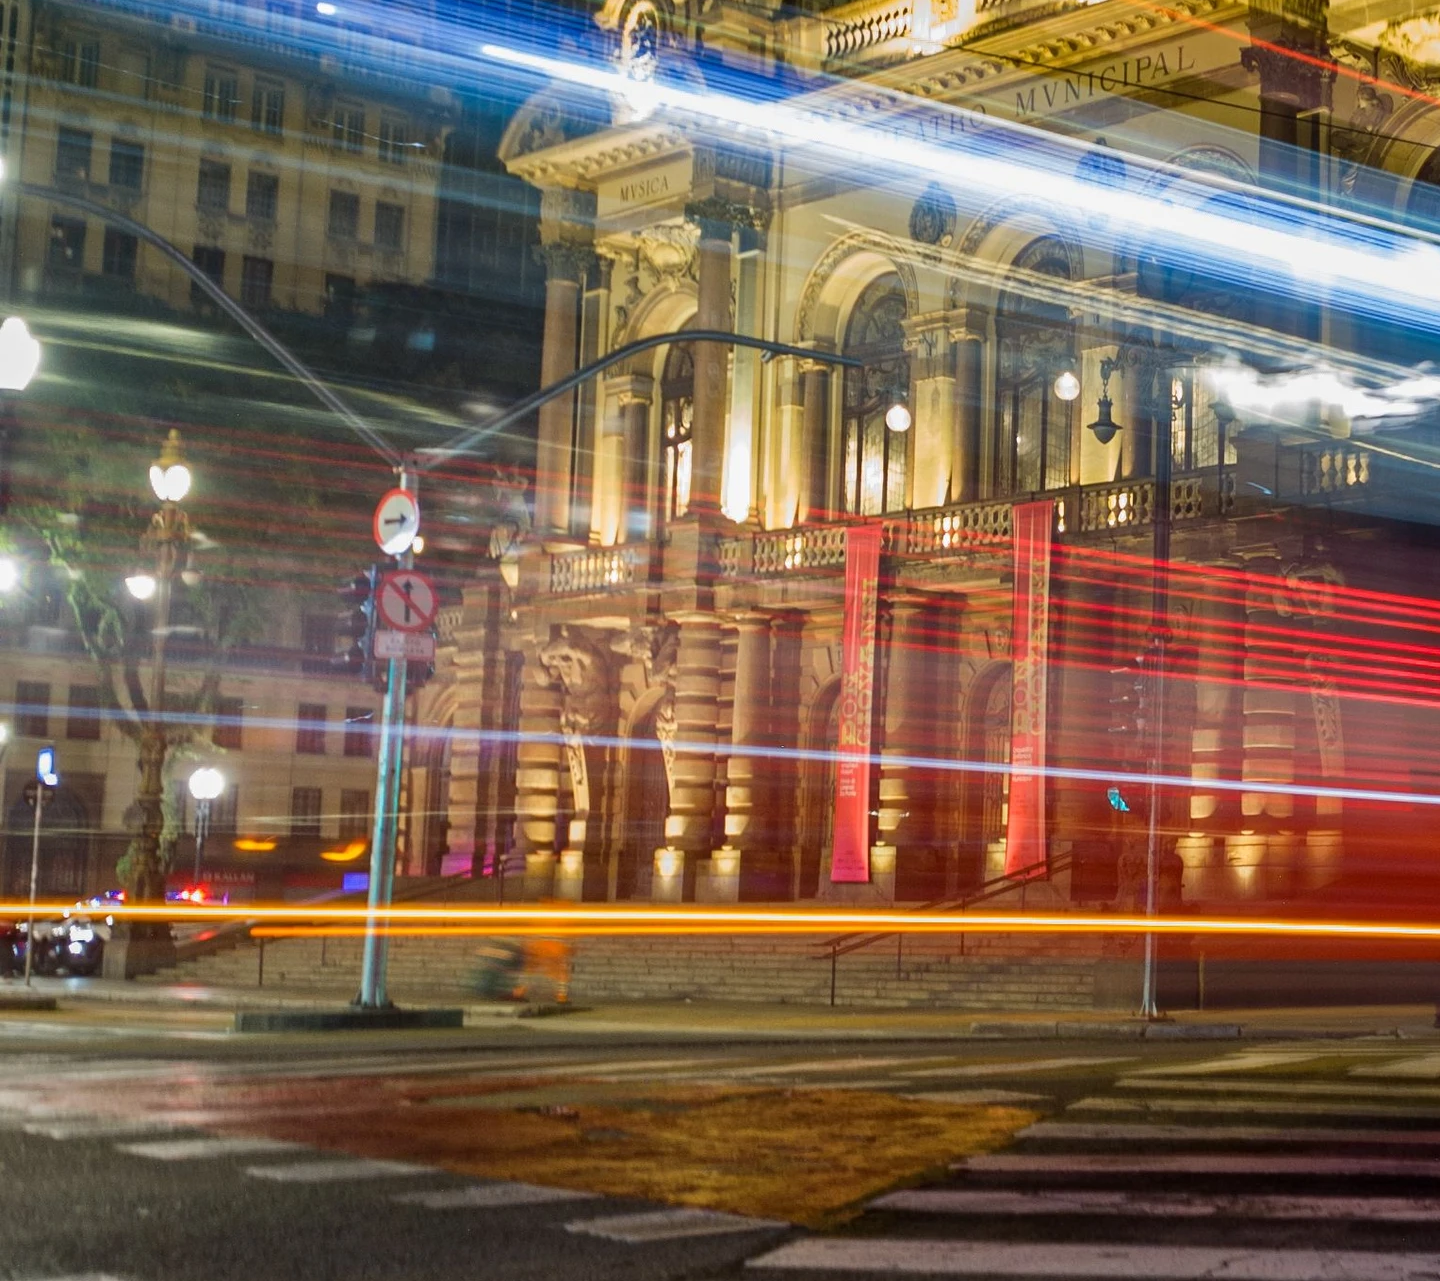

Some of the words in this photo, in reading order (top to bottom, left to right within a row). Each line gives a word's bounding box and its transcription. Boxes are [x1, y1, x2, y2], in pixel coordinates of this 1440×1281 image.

[1015, 45, 1195, 117] MVNICIPAL
[620, 175, 669, 202] MVSICA
[840, 671, 858, 745] DON
